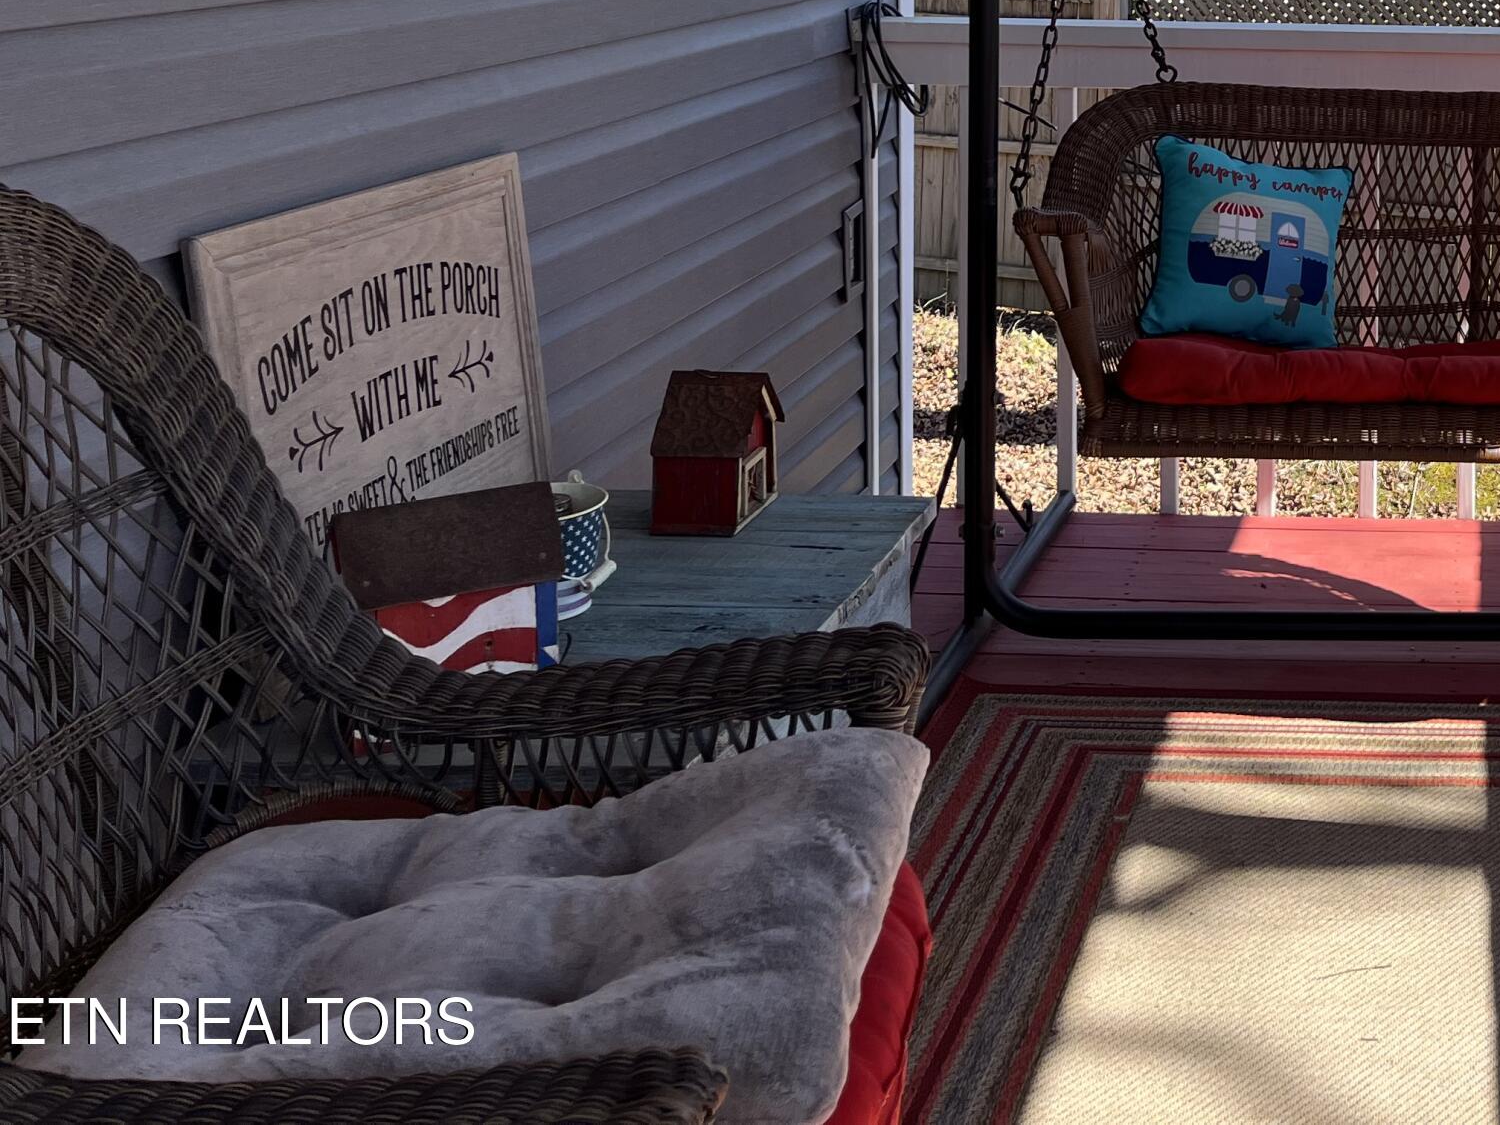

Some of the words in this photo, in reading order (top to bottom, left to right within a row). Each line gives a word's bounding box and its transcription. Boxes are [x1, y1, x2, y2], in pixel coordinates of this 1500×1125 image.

[1188, 151, 1261, 190] happy
[1272, 179, 1343, 202] camper
[257, 314, 320, 416] COME
[320, 287, 355, 362] SIT
[361, 272, 391, 337] ON
[393, 262, 436, 324] THE
[440, 261, 501, 319] PORCH
[350, 364, 412, 444] WITH
[413, 354, 443, 413] ME
[387, 455, 407, 504] &
[405, 452, 430, 492] THE
[494, 405, 520, 444] FREE
